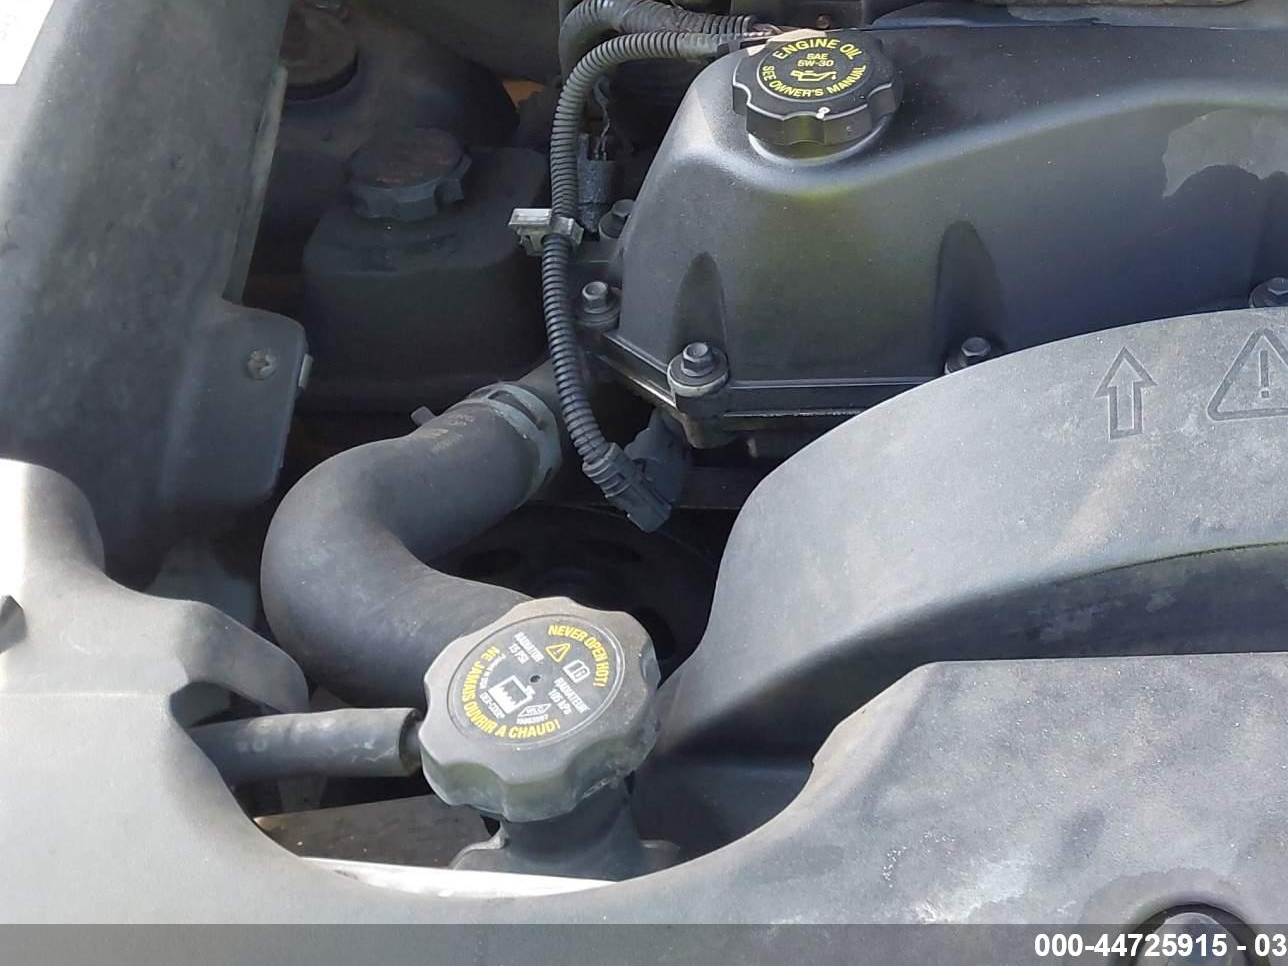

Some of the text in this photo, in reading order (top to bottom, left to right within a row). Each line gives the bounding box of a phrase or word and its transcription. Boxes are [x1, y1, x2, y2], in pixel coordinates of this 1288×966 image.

[772, 38, 863, 60] ENGINE OIL
[762, 65, 867, 97] SEE OWNER'S MANUAL
[481, 646, 498, 661] NE
[508, 643, 519, 655] 15
[514, 632, 544, 662] RADIATOR
[547, 624, 610, 688] NEVER OPEN HOT!
[462, 661, 485, 702] JAMAIS
[464, 701, 497, 734] OUVRIR
[509, 719, 561, 739] CHAUD!
[495, 727, 506, 738] A
